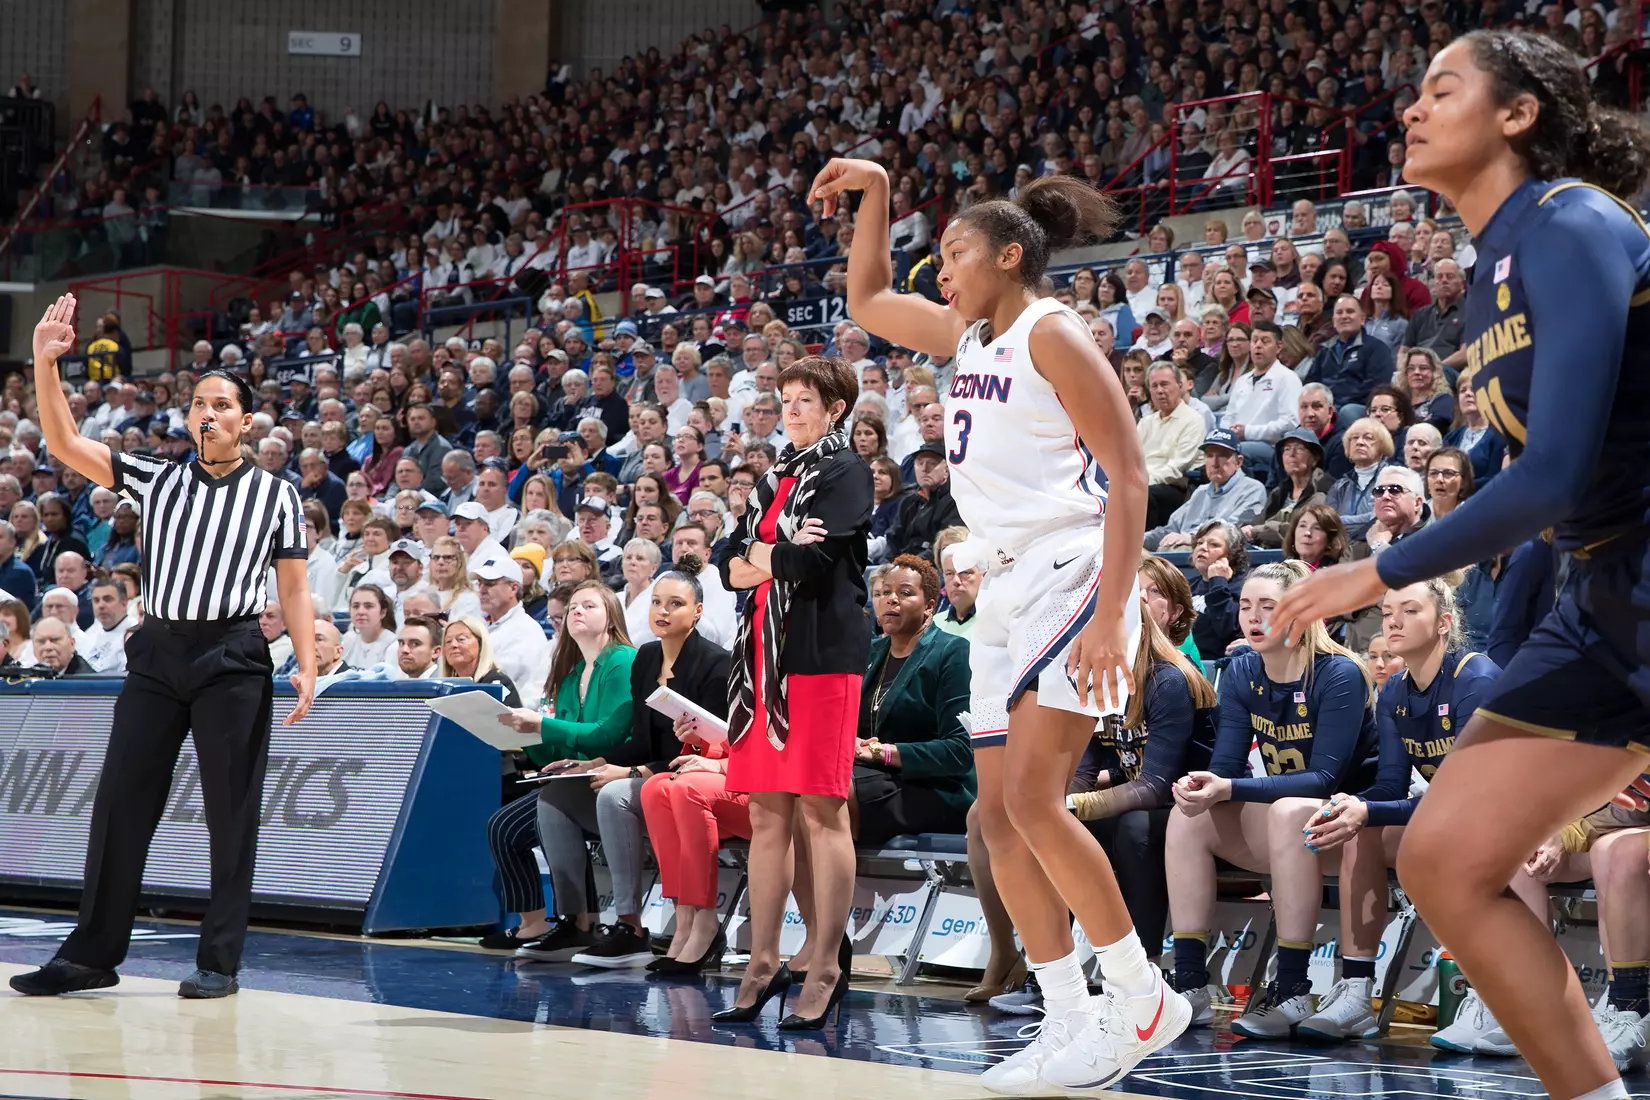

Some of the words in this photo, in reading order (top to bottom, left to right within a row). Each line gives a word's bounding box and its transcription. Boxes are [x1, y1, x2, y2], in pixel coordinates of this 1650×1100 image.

[291, 38, 314, 49] SEC
[340, 36, 352, 52] 9
[788, 305, 813, 322] SEC
[819, 296, 853, 324] 12
[949, 409, 972, 465] 3
[1276, 722, 1313, 742] DAME
